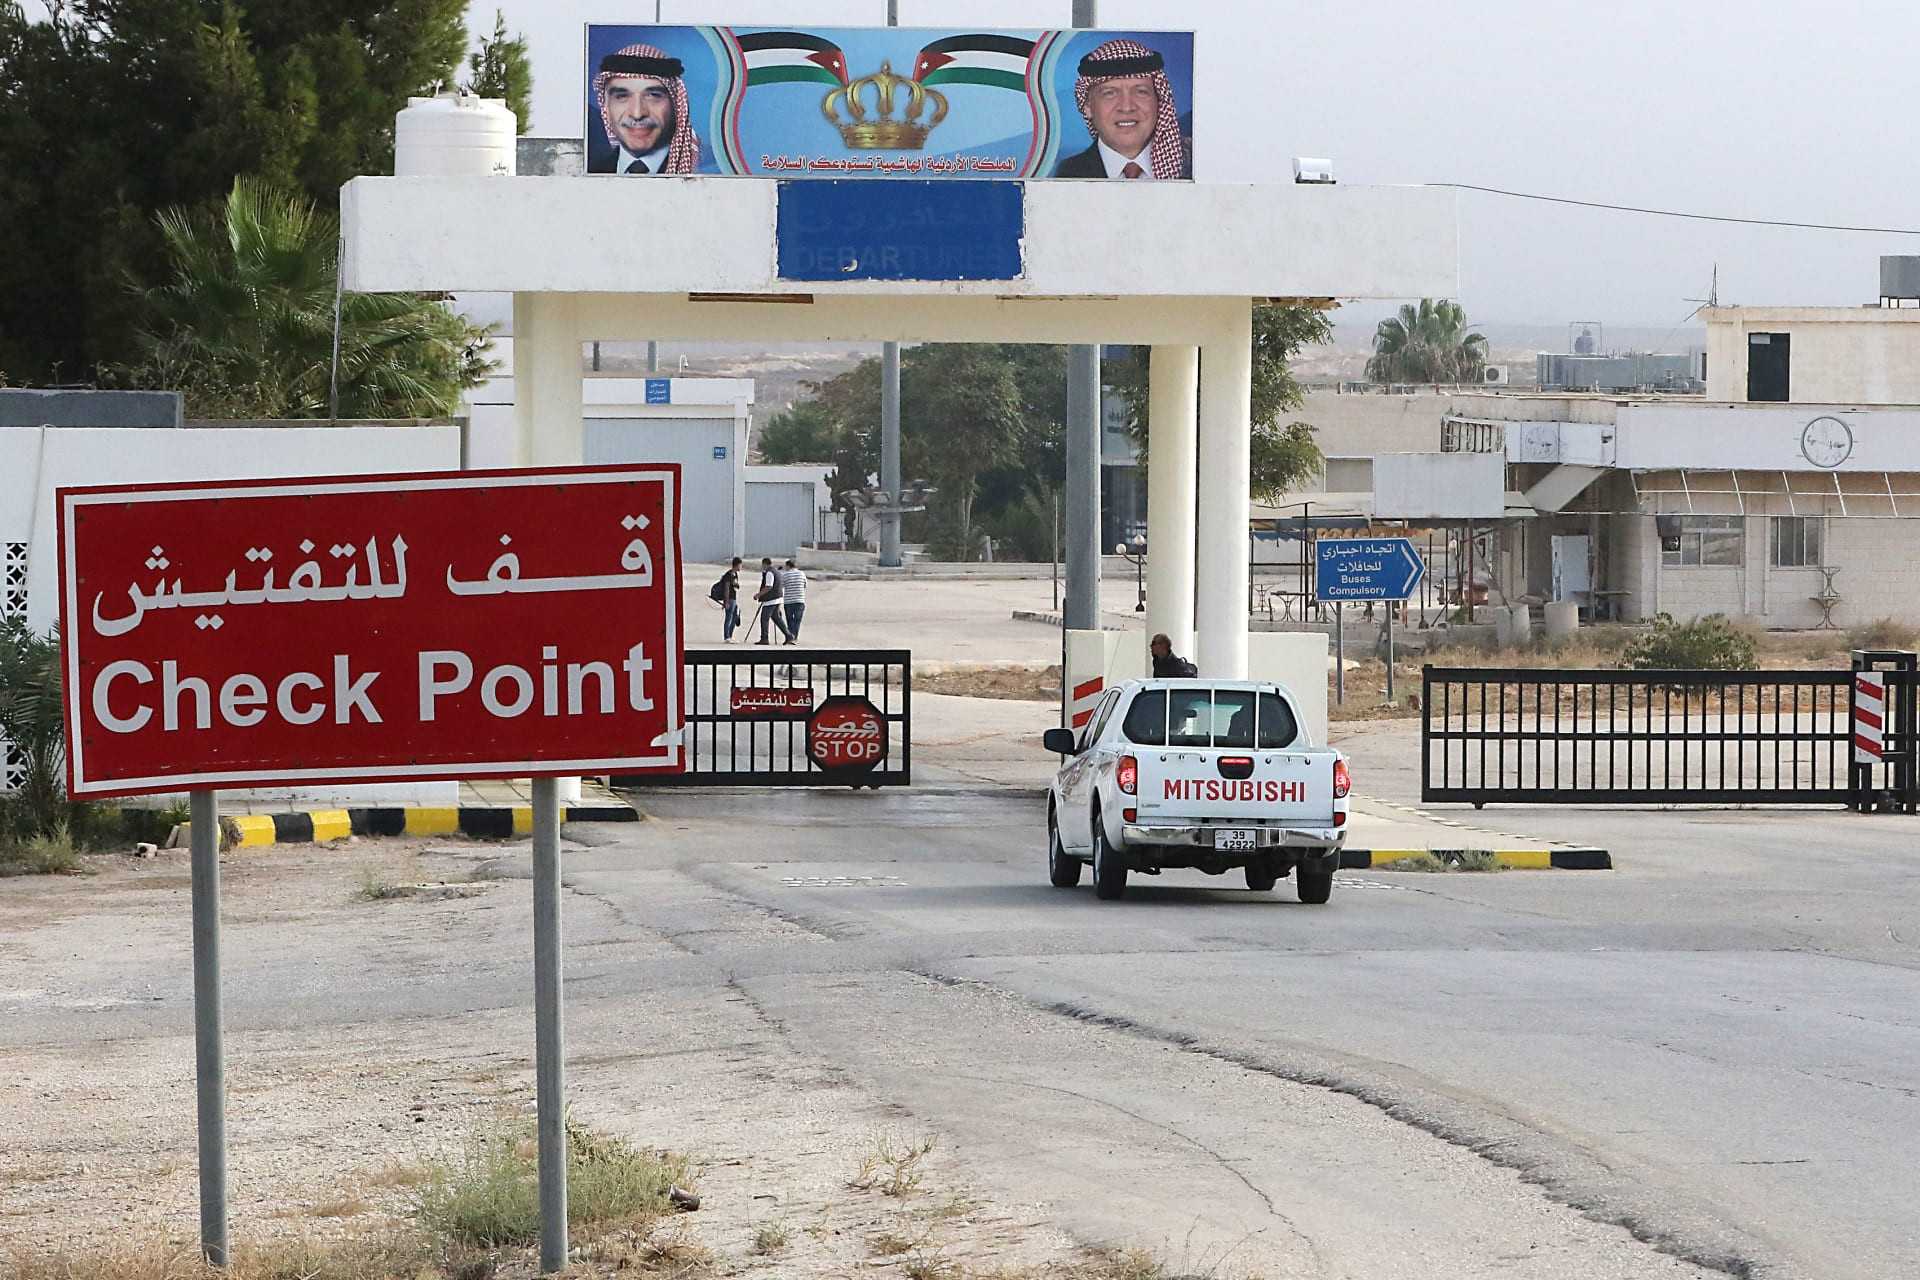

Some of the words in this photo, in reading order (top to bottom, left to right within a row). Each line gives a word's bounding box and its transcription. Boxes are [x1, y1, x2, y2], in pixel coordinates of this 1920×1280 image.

[761, 155, 805, 169] السلامة
[808, 156, 873, 173] تستودعكم
[876, 156, 925, 174] الهاشمية
[927, 155, 969, 174] الأردنية
[972, 156, 1017, 172] المملكة
[446, 513, 654, 597] قف
[1322, 544, 1362, 561] اجباري
[1365, 543, 1396, 556] اتجاه
[1337, 560, 1382, 573] للحافلات
[92, 533, 408, 637] للتفتيش
[1341, 575, 1371, 584] Buses
[1328, 586, 1386, 597] Compulsory
[91, 653, 384, 735] Check
[417, 641, 656, 723] Point
[789, 692, 813, 708] قف
[816, 713, 880, 735] قف
[813, 740, 881, 759] STOP
[1163, 779, 1306, 802] MITSUBISHI
[1232, 830, 1245, 840] 39
[1222, 840, 1255, 849] 42922
